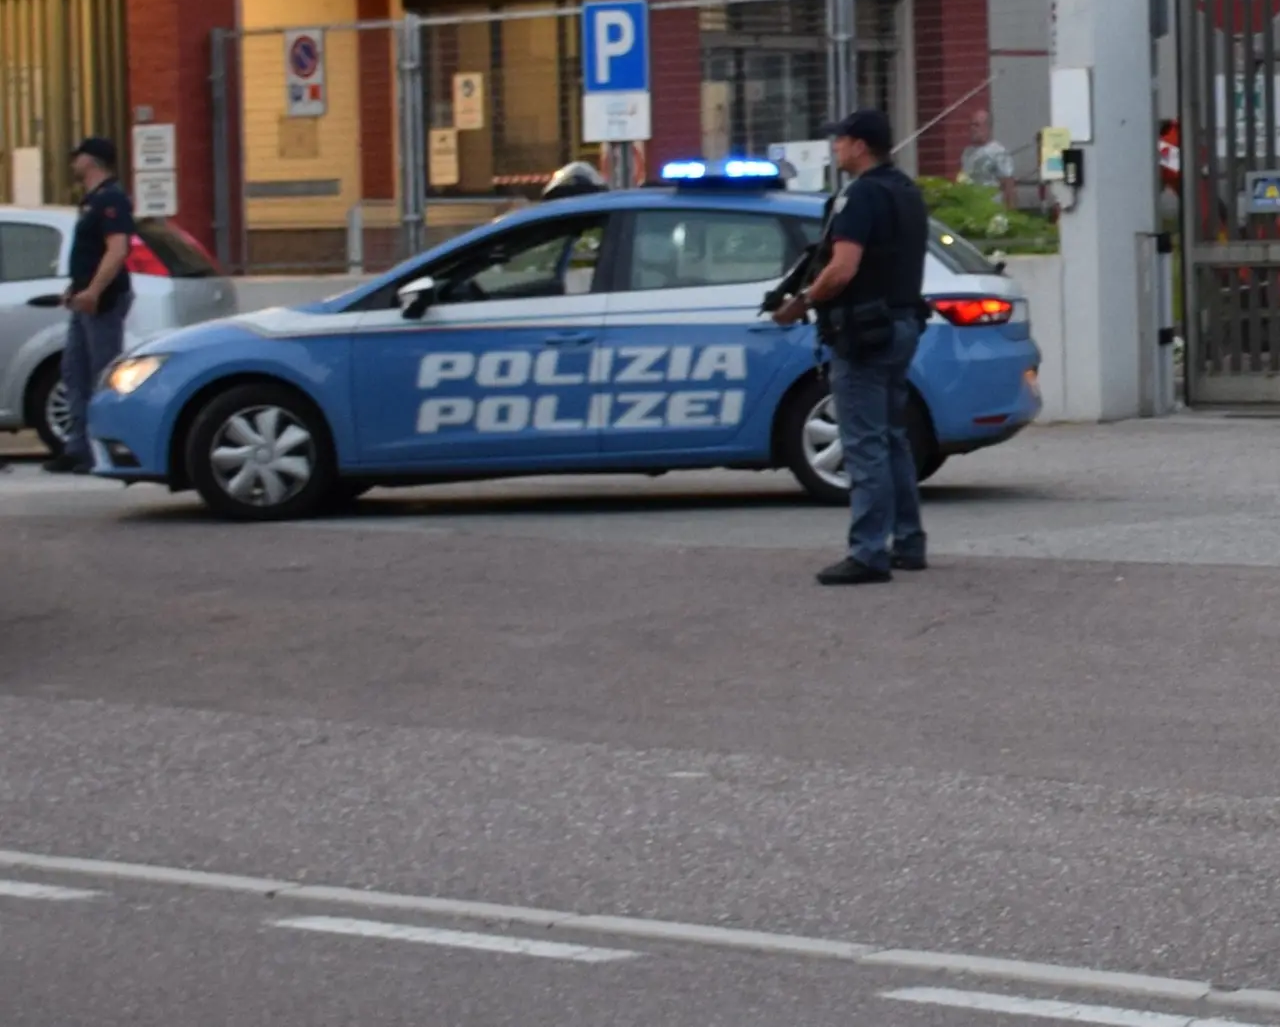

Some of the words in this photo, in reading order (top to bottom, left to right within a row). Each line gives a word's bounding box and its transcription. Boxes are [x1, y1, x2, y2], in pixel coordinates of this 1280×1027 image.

[595, 10, 635, 83] P
[417, 344, 747, 389] POLIZIA
[416, 390, 747, 434] POLIZEI
